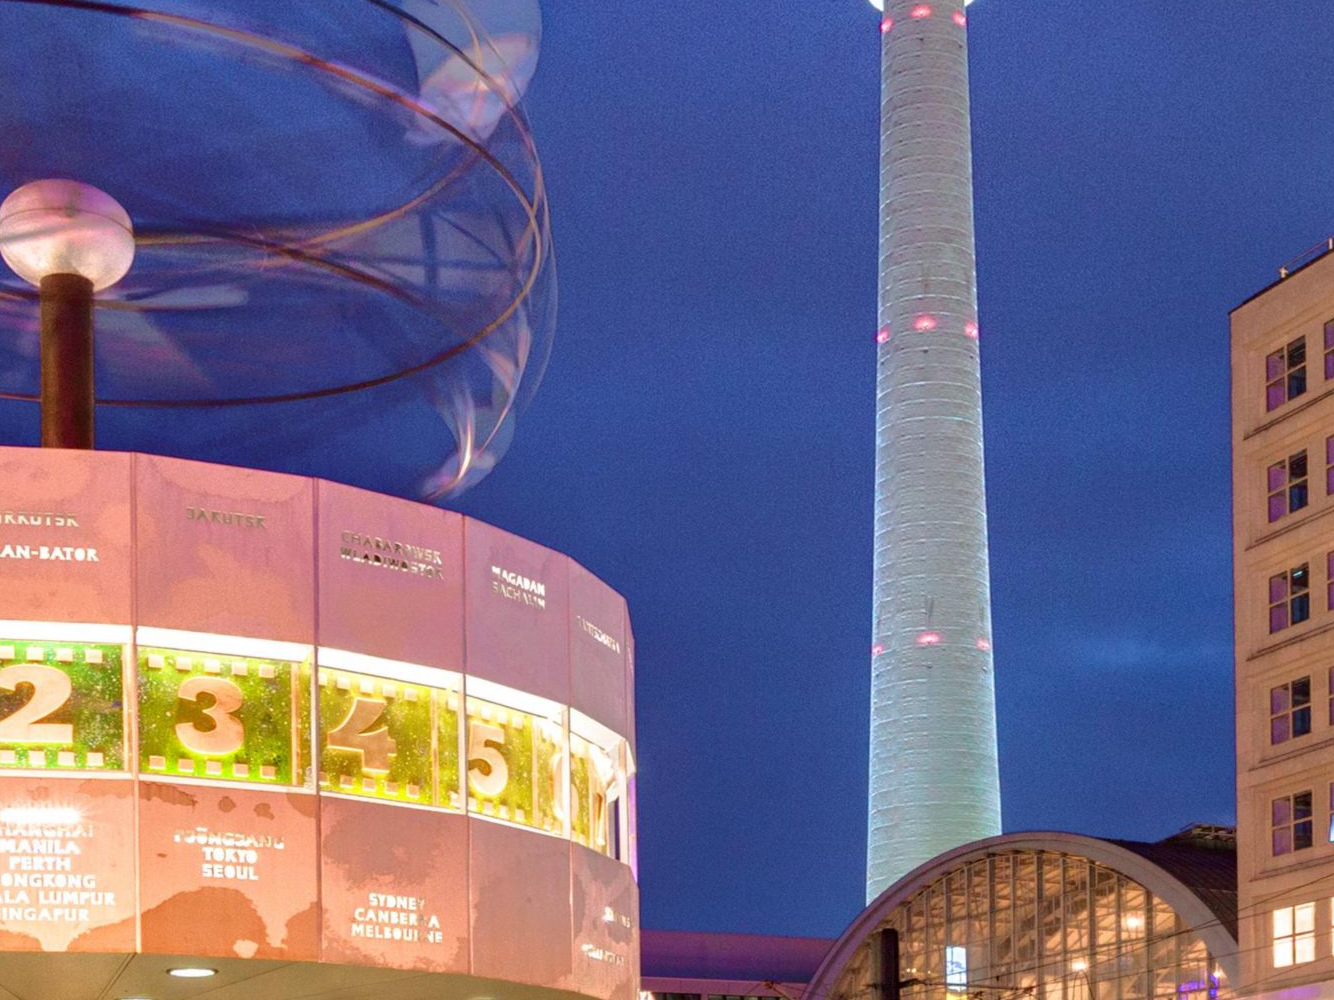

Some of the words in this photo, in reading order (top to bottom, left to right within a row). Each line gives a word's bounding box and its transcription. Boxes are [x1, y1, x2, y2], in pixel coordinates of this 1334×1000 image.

[187, 506, 267, 529] JAKUTSK
[491, 565, 546, 596] MAGADAN
[174, 675, 245, 756] 3
[326, 697, 397, 775] 4
[467, 722, 509, 797] 5
[9, 856, 72, 872] PERTH
[202, 846, 259, 865] TOKYO
[202, 863, 259, 881] SEOUL
[38, 890, 116, 906] LUMPUR
[368, 892, 425, 911] SYDNEY
